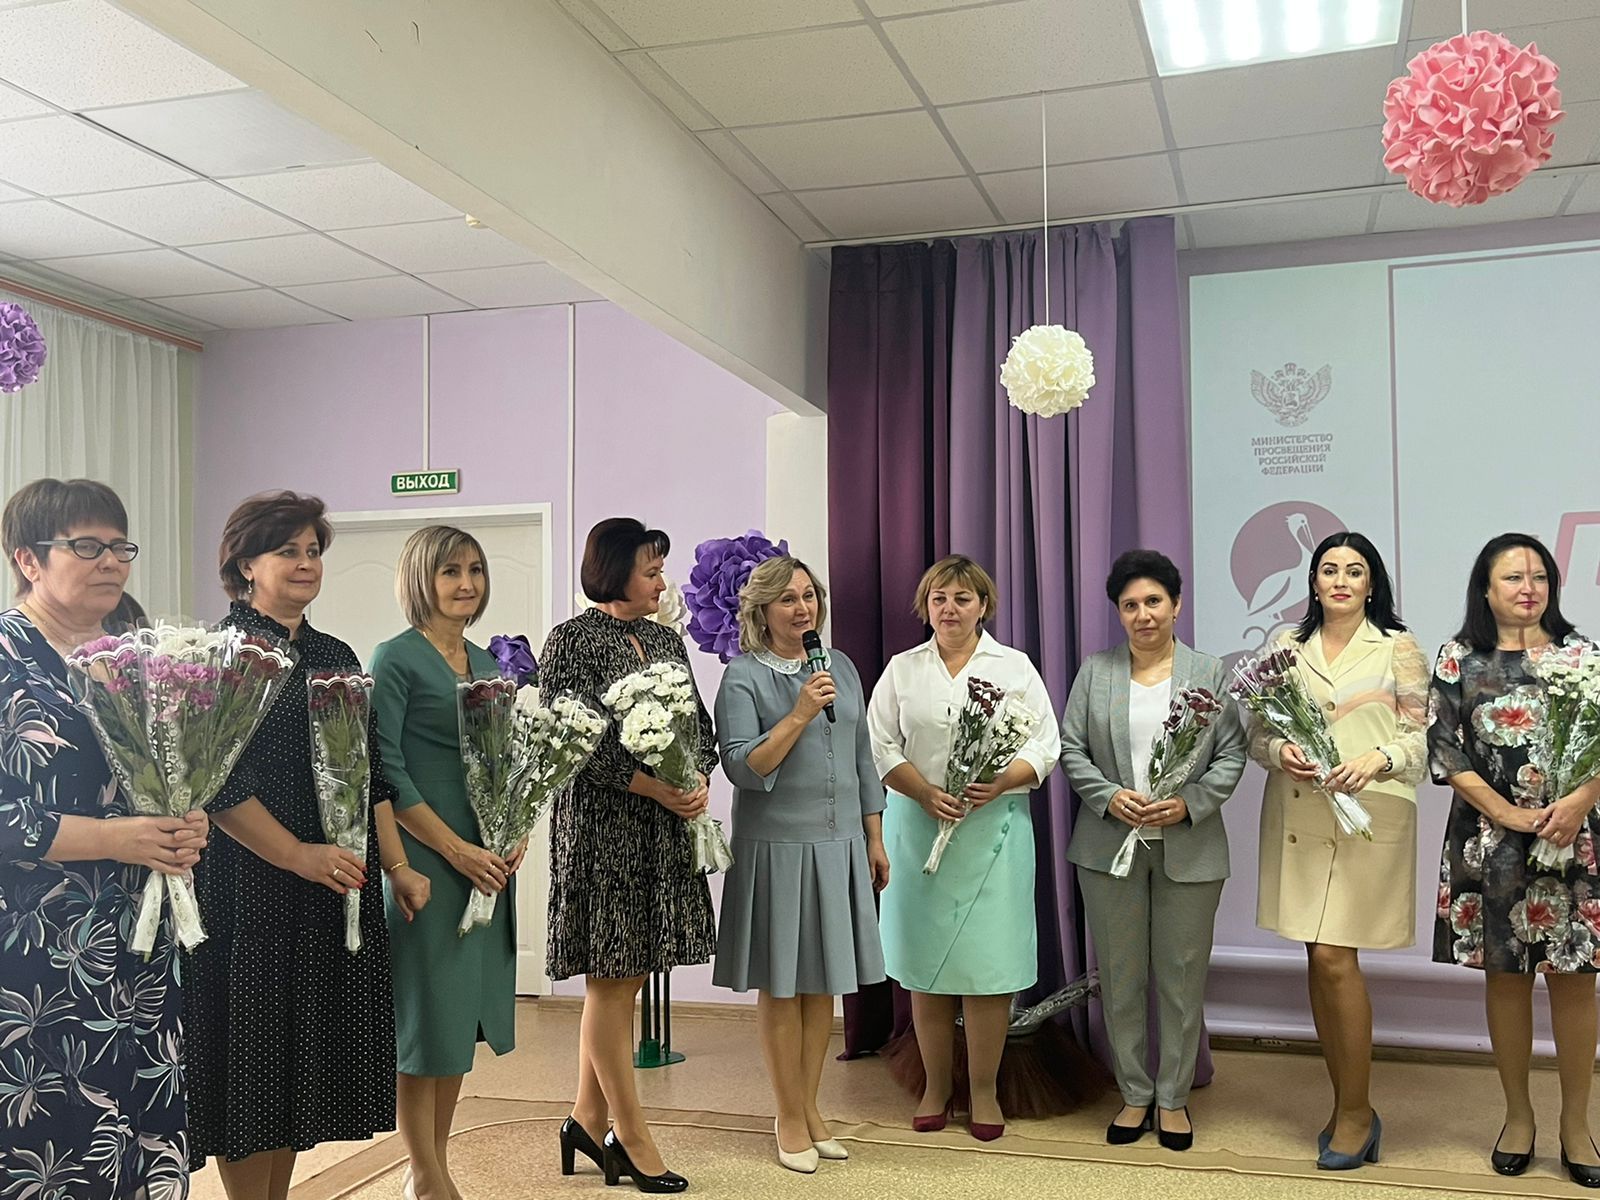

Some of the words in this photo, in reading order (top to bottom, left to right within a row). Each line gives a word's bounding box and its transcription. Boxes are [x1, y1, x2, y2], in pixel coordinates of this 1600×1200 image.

[1251, 433, 1333, 446] МИНИСТЕРСТВО
[1254, 444, 1331, 456] ПРОСВЕЩЕНИЯ
[1258, 454, 1326, 465] РОССИЙСКОЙ
[1261, 464, 1324, 475] ФЕДЕРАЦИИ
[396, 474, 450, 489] ВЫХОД
